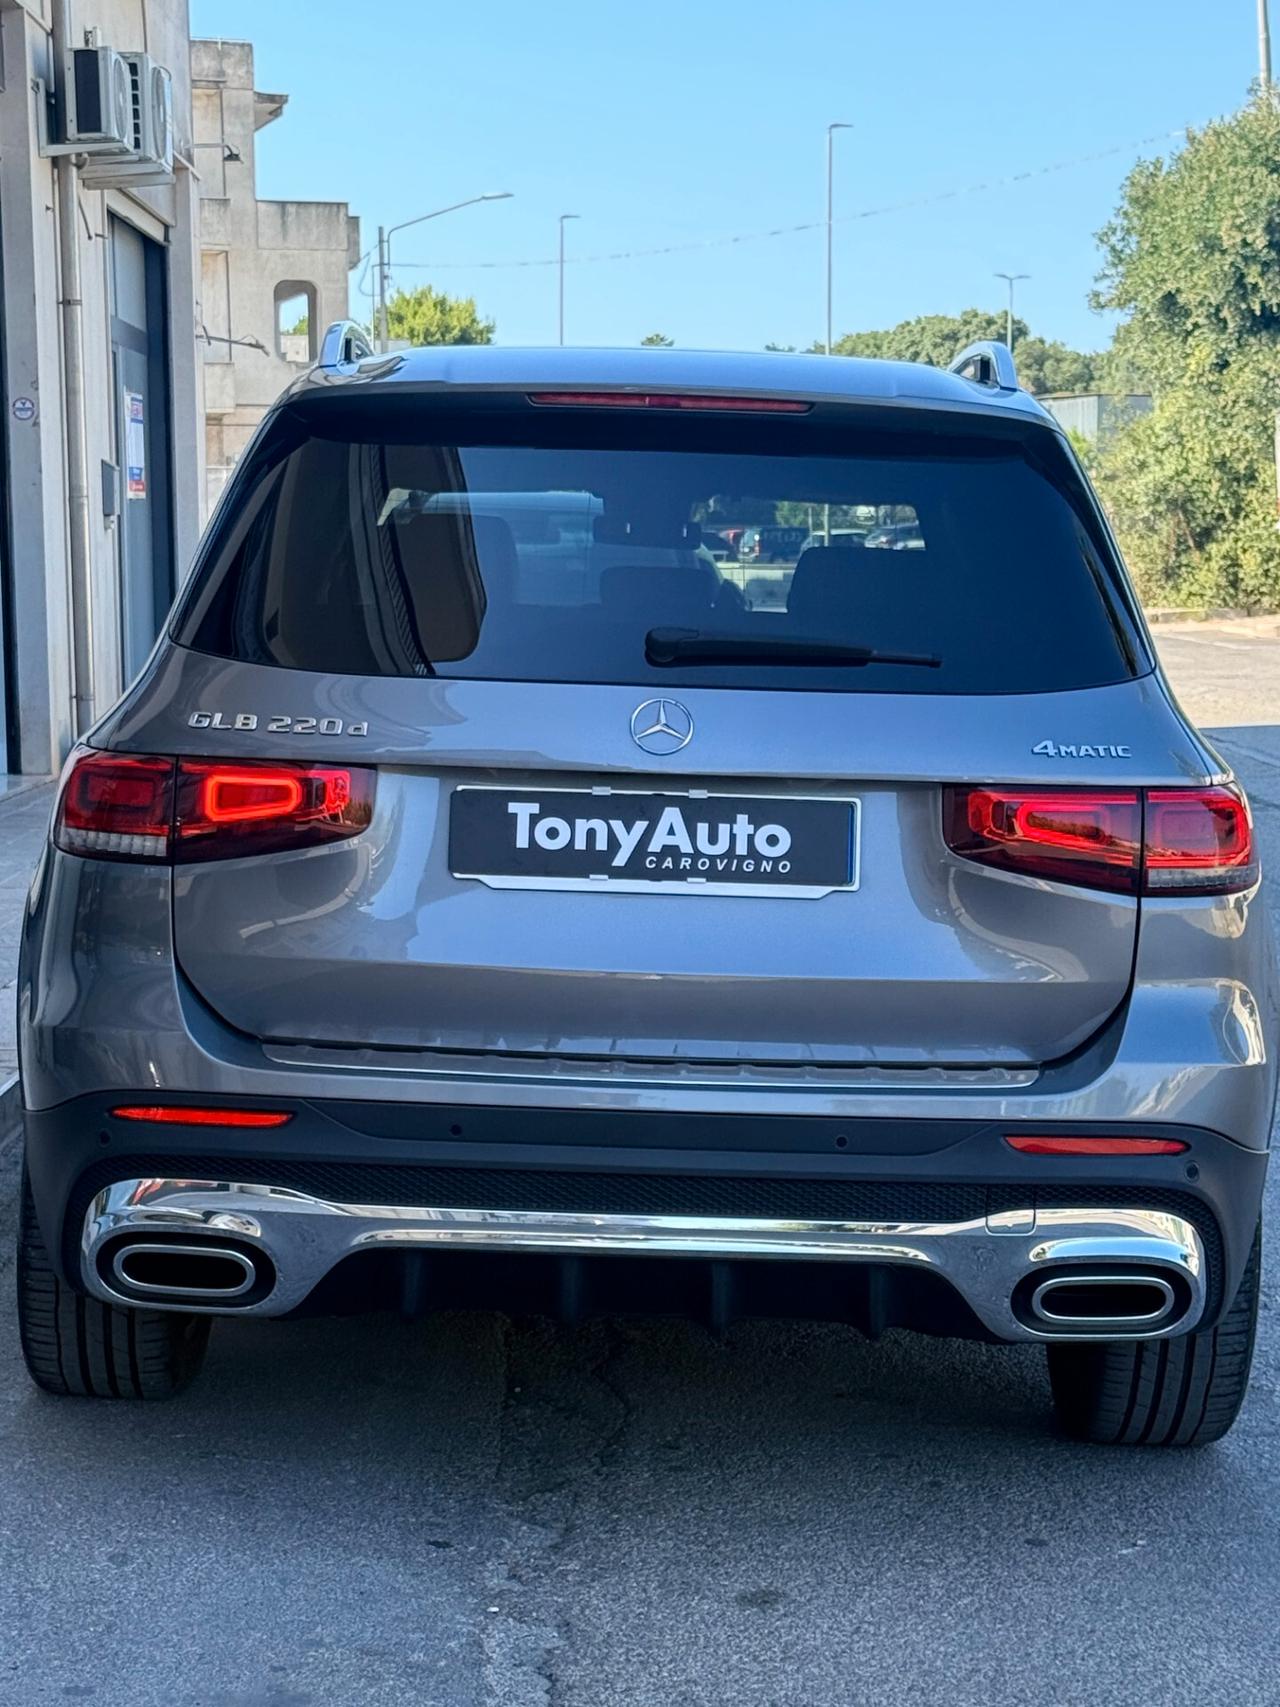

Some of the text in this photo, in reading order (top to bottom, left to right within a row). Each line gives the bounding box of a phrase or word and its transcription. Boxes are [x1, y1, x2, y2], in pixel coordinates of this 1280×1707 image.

[188, 711, 258, 731] GLB
[1032, 740, 1132, 757] 4MATIC
[645, 856, 792, 873] CAROVIGNO
